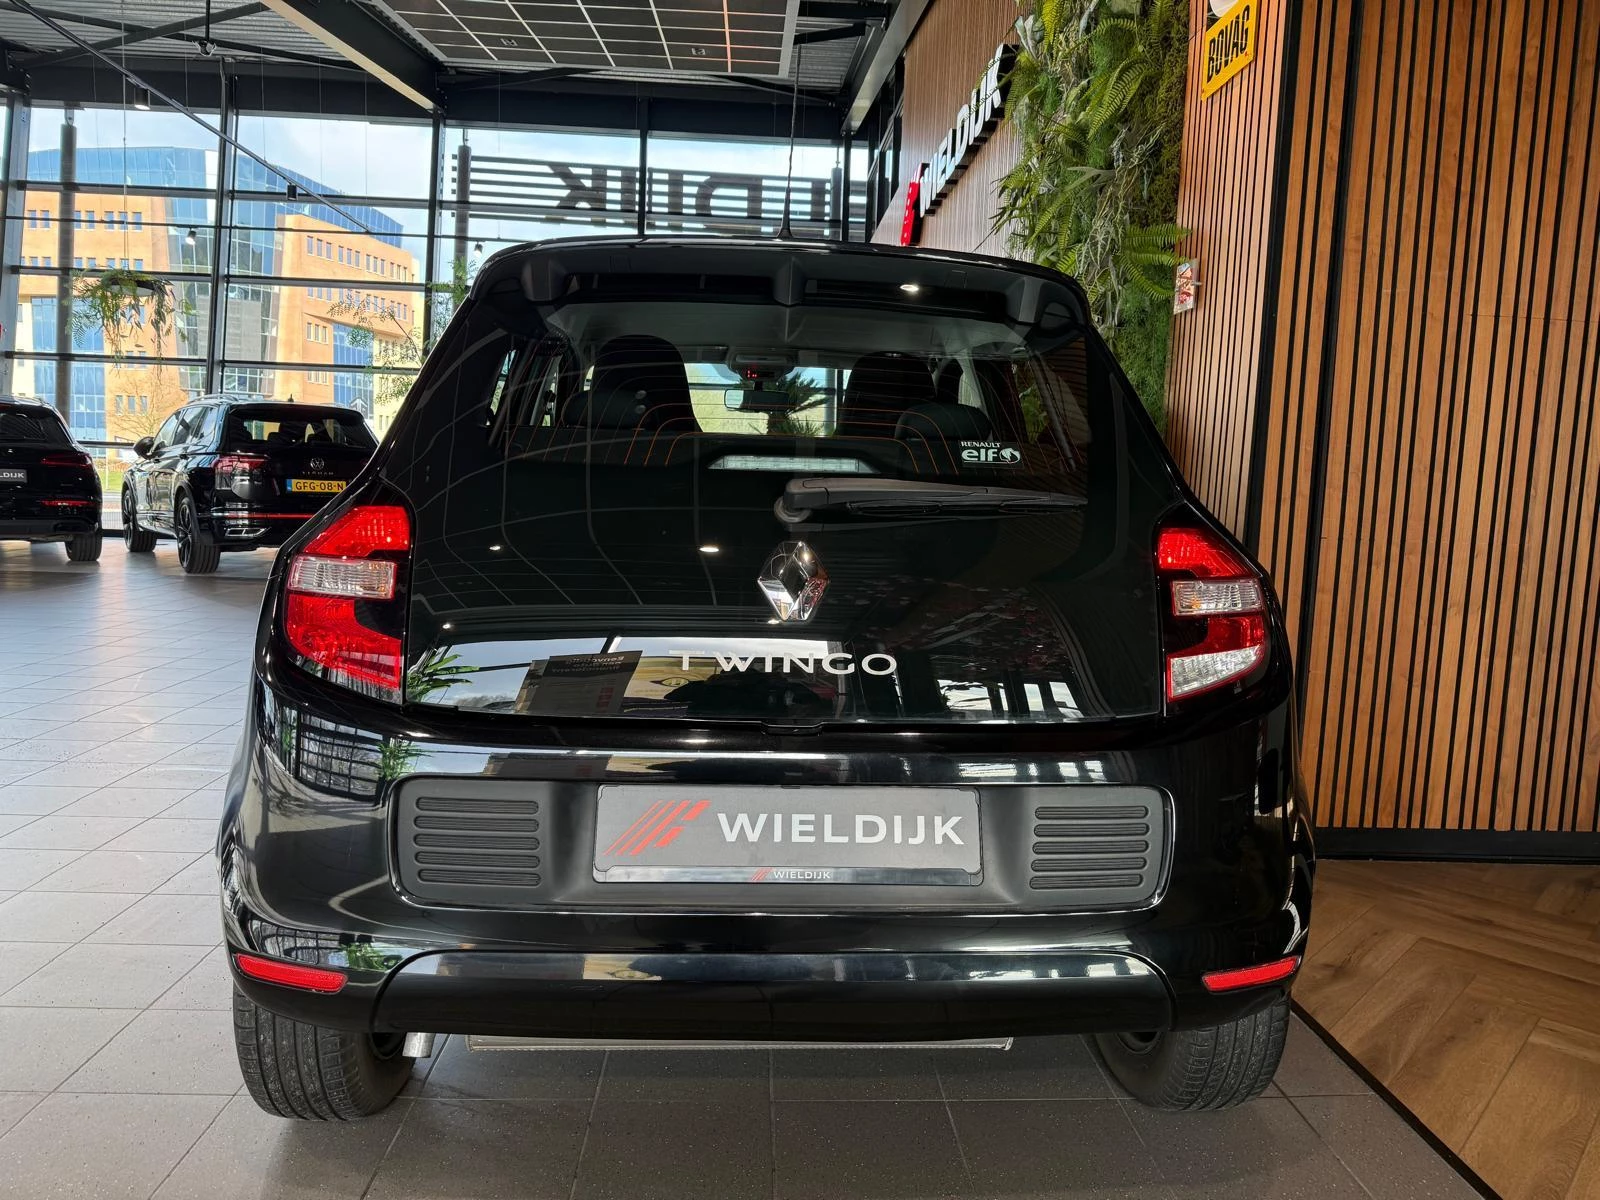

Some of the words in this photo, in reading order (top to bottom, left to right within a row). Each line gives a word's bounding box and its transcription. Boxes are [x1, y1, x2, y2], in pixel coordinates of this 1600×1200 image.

[1206, 4, 1250, 84] BOVAG
[919, 43, 1003, 218] WIELDIJK
[960, 440, 1001, 448] RENAULT
[961, 448, 998, 462] elf
[295, 481, 344, 491] GFG-08-N
[668, 649, 898, 676] TWINGO
[717, 812, 965, 845] WIELDIJK
[773, 871, 831, 879] WIELDIJK
